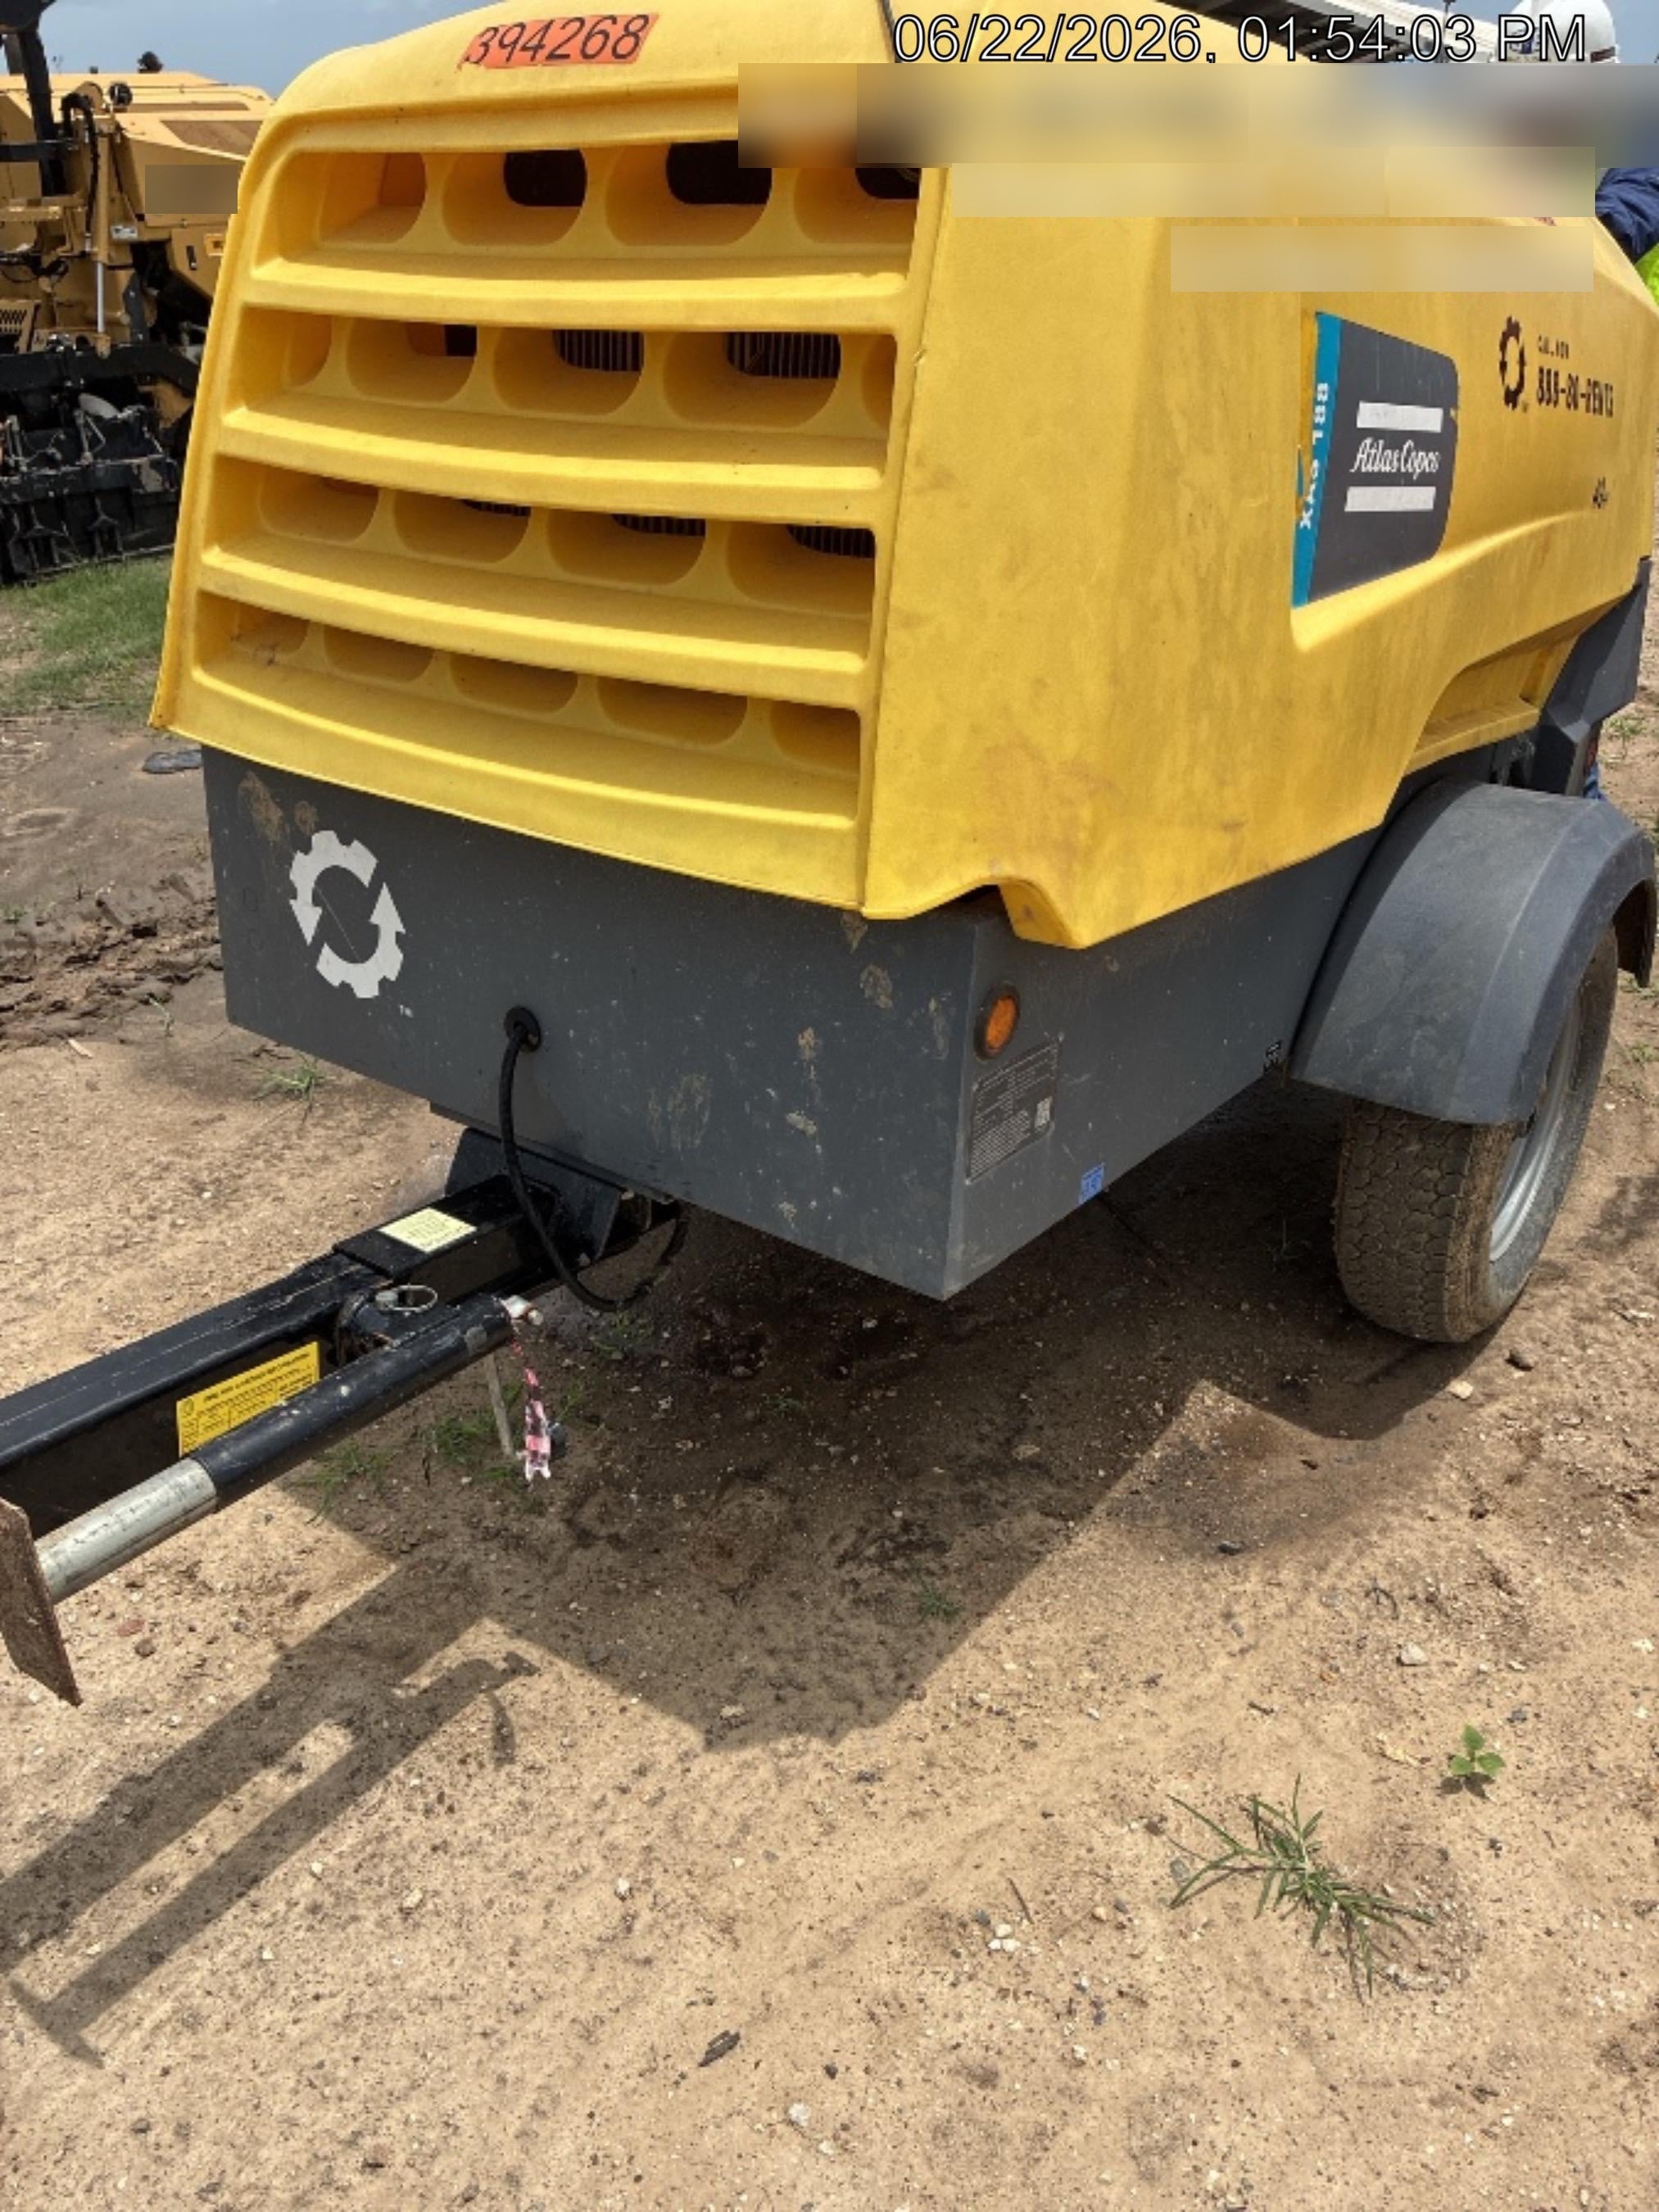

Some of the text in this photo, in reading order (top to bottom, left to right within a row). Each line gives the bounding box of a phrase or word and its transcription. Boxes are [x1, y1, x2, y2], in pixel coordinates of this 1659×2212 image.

[463, 14, 650, 65] 394268
[1312, 383, 1329, 445] 188
[1349, 437, 1400, 473] Atlas
